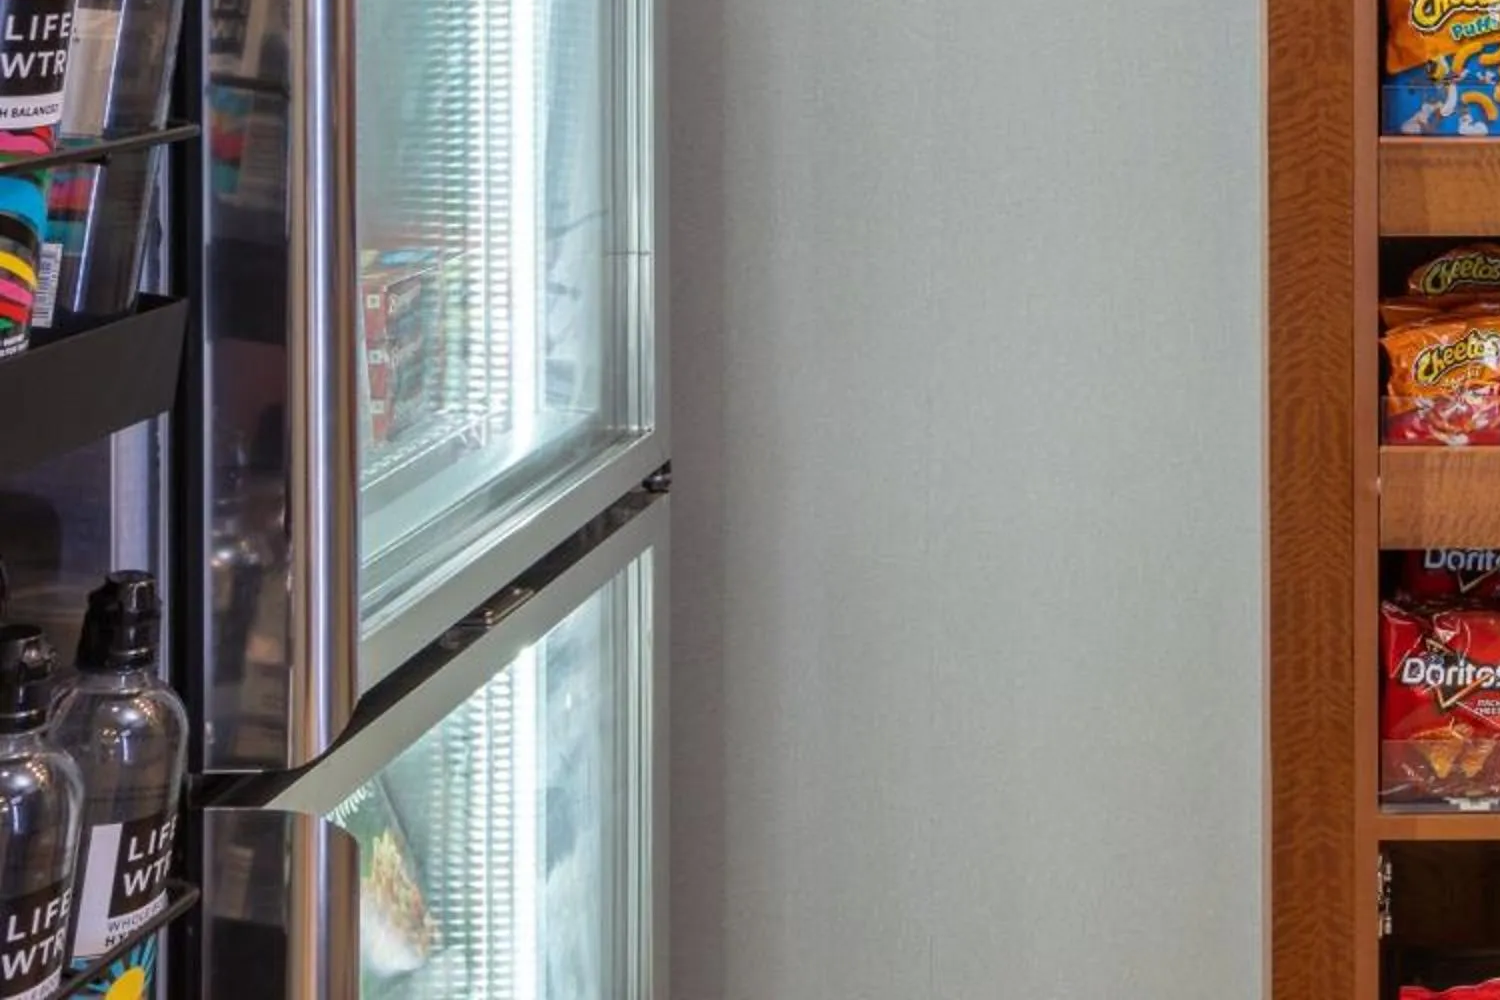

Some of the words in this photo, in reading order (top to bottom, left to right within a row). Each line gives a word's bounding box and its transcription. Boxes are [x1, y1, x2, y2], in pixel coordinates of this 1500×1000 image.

[5, 12, 72, 41] LIFE
[1, 49, 67, 79] WTR
[7, 888, 73, 943] LIFE
